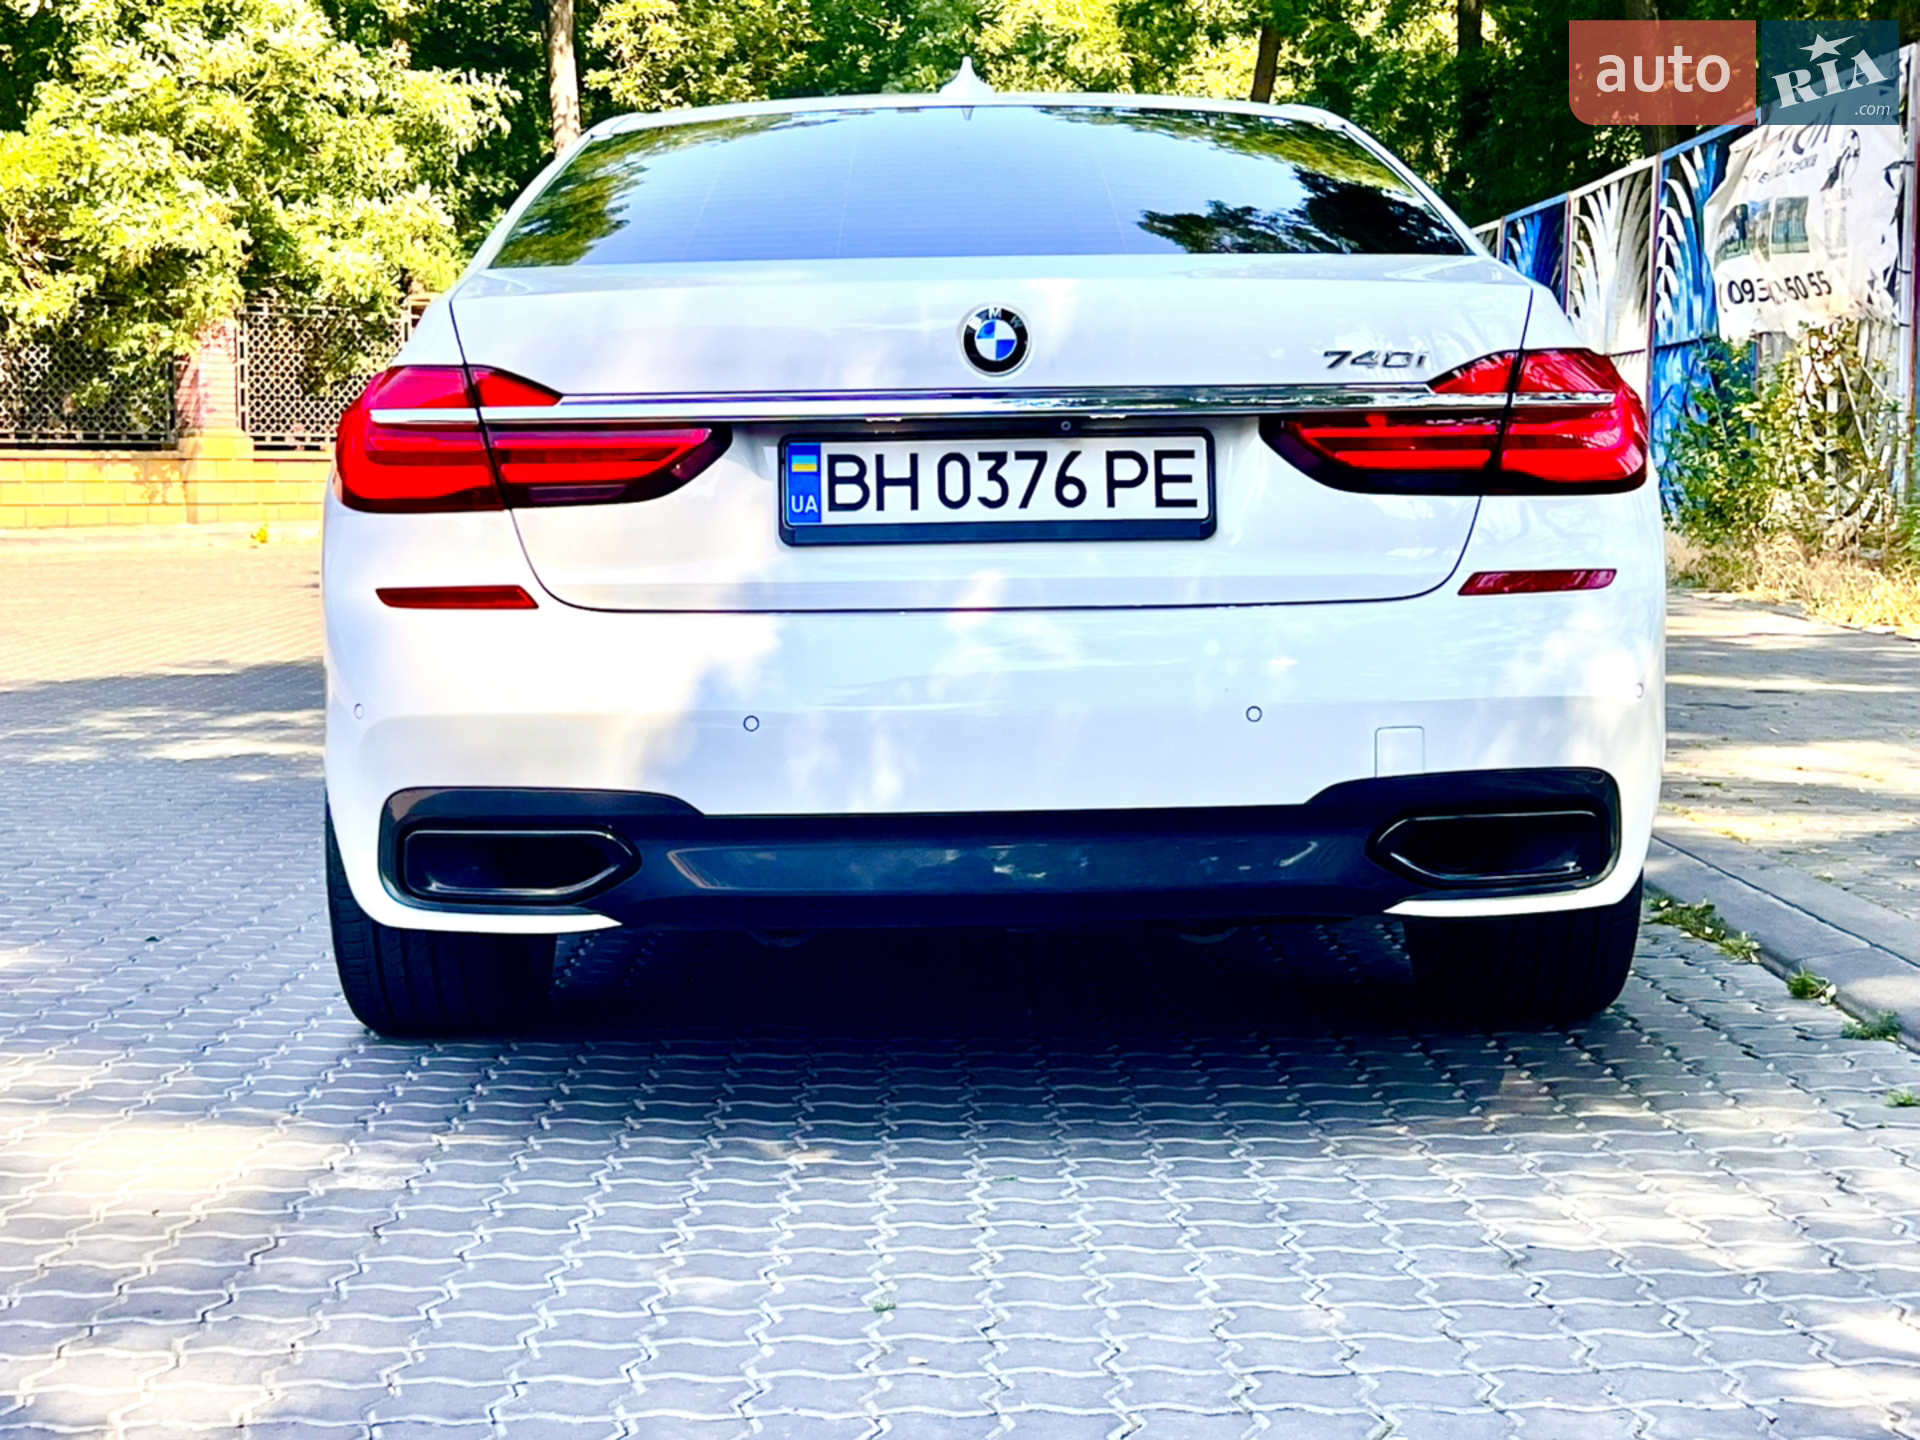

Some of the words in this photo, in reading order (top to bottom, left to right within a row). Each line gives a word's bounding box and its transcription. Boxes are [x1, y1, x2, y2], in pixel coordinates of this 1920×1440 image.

[1323, 350, 1429, 369] 740i
[827, 452, 919, 512] BH
[937, 450, 1088, 510] 0376
[1105, 450, 1198, 509] PE
[790, 494, 819, 514] UA
